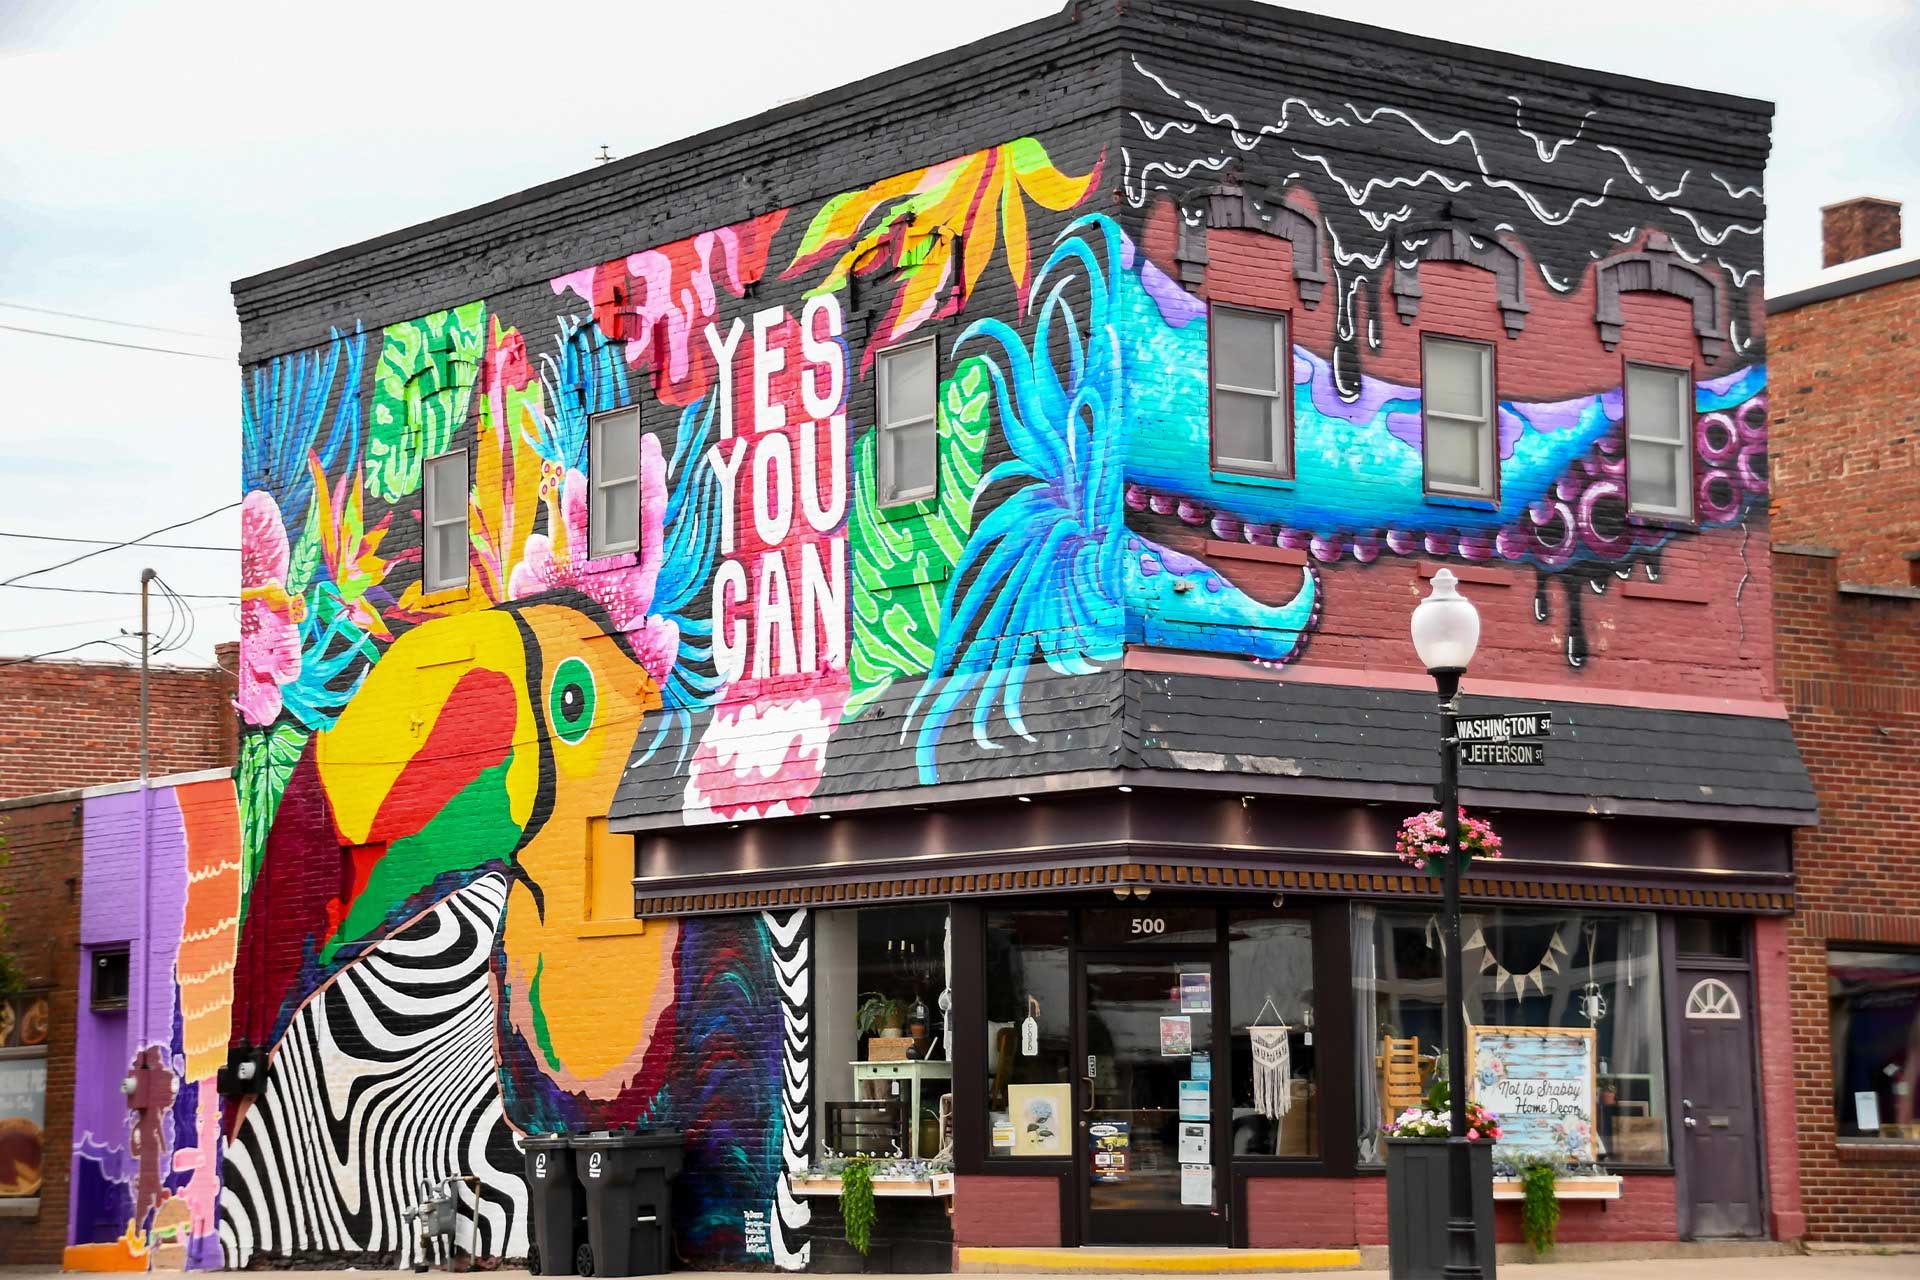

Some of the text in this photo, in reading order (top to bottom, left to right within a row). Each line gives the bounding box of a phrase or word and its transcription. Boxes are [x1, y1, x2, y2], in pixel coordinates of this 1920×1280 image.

[704, 293, 842, 439] YES
[707, 415, 847, 555] YOU
[712, 537, 846, 683] CAN
[1456, 717, 1536, 738] WASHINGTON
[1461, 749, 1466, 758] N
[1468, 745, 1532, 763] JEFFERSON
[1131, 918, 1165, 934] 500
[1499, 1080, 1581, 1101] Not to Shabby
[1516, 1097, 1582, 1114] Home Decor
